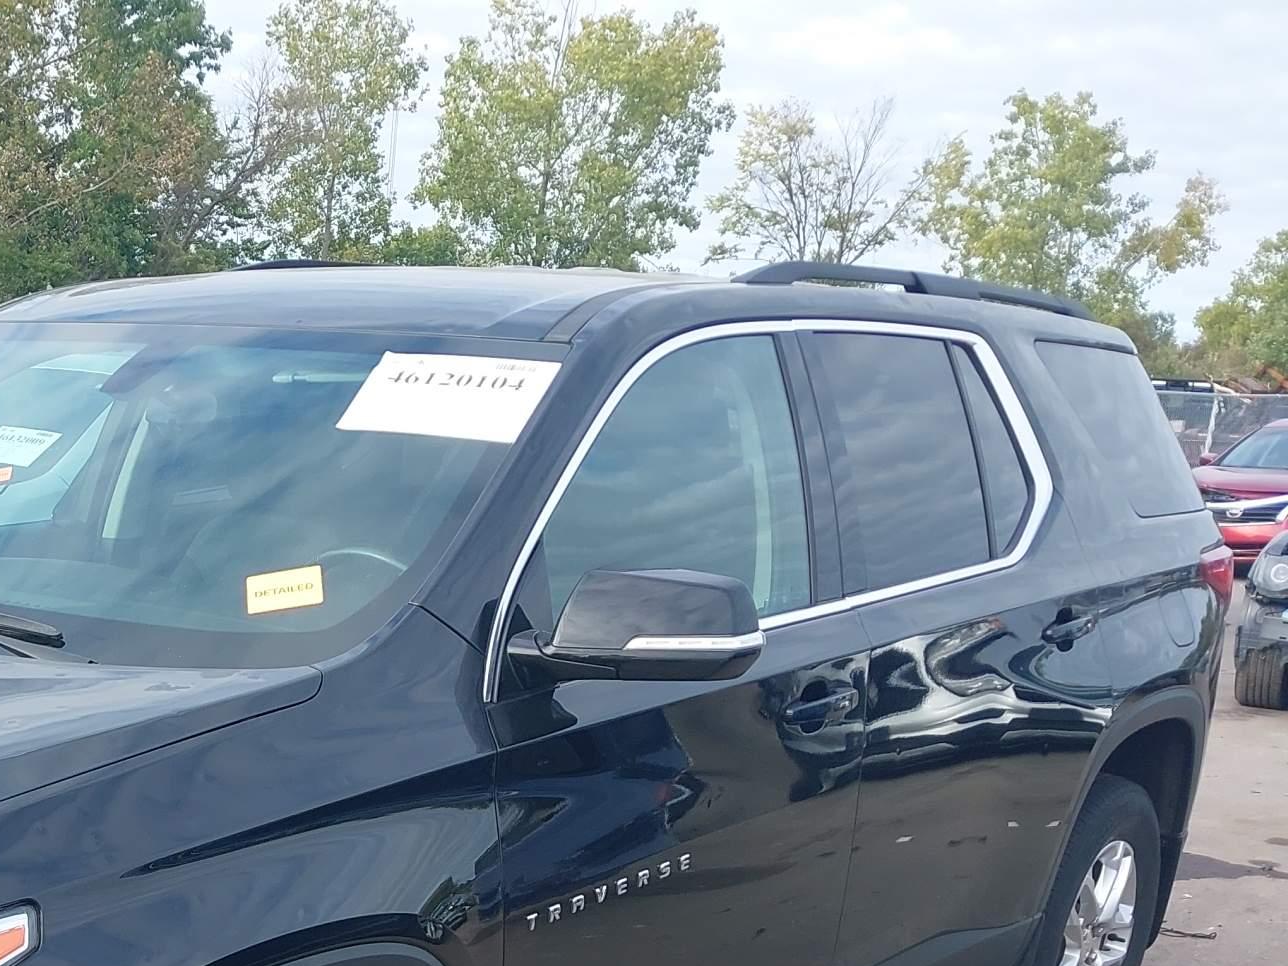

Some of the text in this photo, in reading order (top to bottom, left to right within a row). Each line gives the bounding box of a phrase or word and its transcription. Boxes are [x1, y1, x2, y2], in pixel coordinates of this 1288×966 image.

[387, 371, 527, 391] 46120104
[254, 582, 314, 598] DETAILED
[526, 853, 691, 931] TRAVERSE
